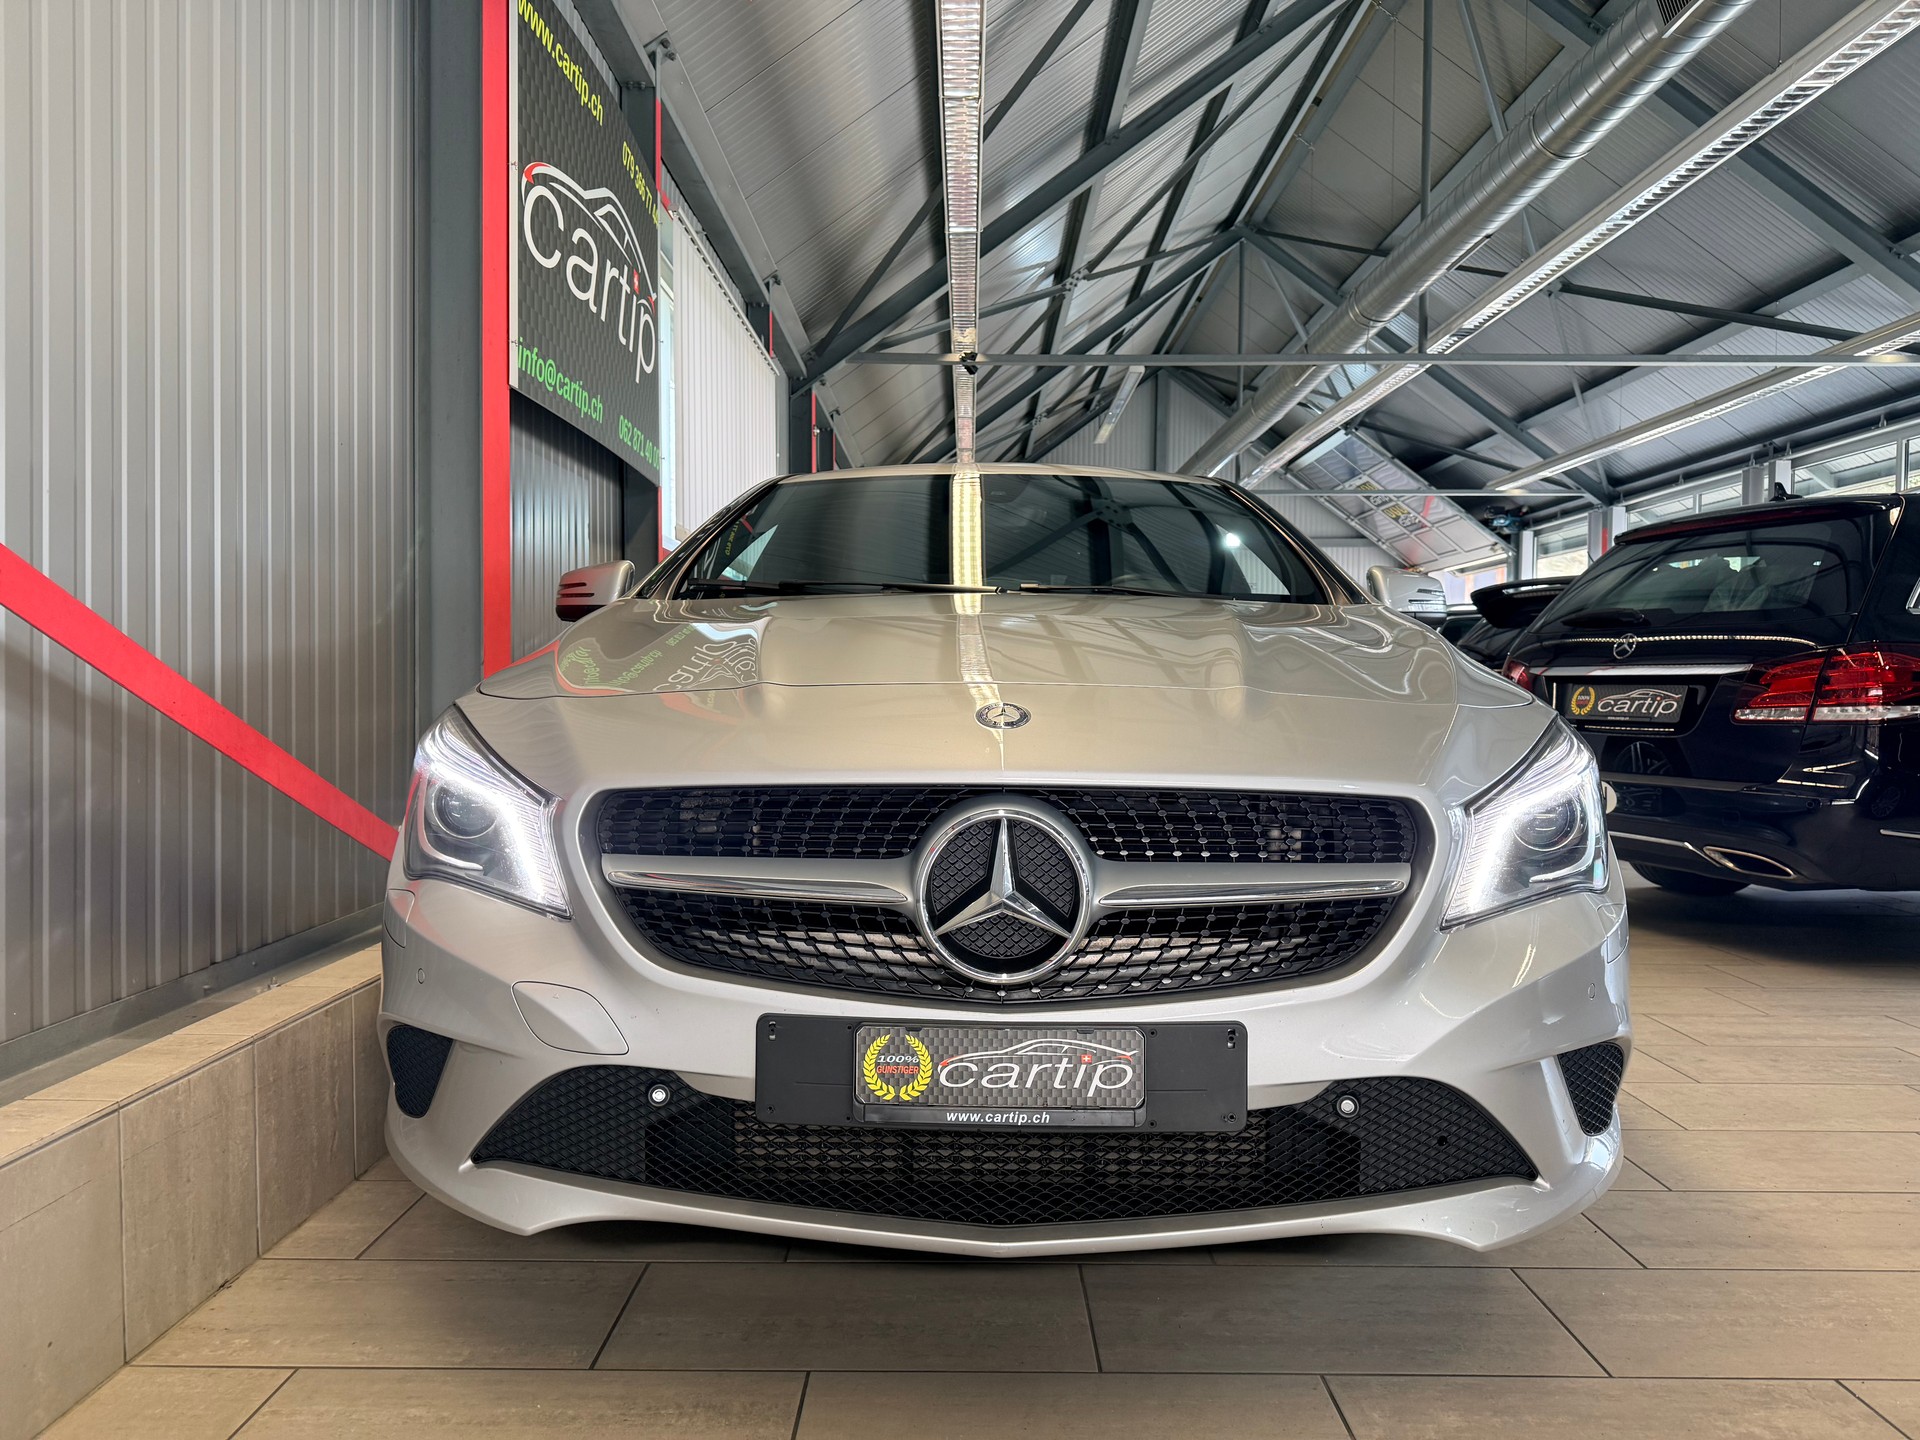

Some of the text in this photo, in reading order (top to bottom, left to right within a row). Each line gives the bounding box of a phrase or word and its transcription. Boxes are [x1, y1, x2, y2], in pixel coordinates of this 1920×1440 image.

[518, 0, 603, 126] www.cartip.ch
[622, 140, 635, 180] 079
[518, 337, 604, 424] info@cartip.ch
[619, 415, 633, 447] 062
[632, 427, 645, 457] 871
[1597, 697, 1678, 718] cartip
[877, 1055, 920, 1063] 100%
[938, 1054, 1134, 1097] cartip
[946, 1109, 1050, 1126] www.cartip.ch
